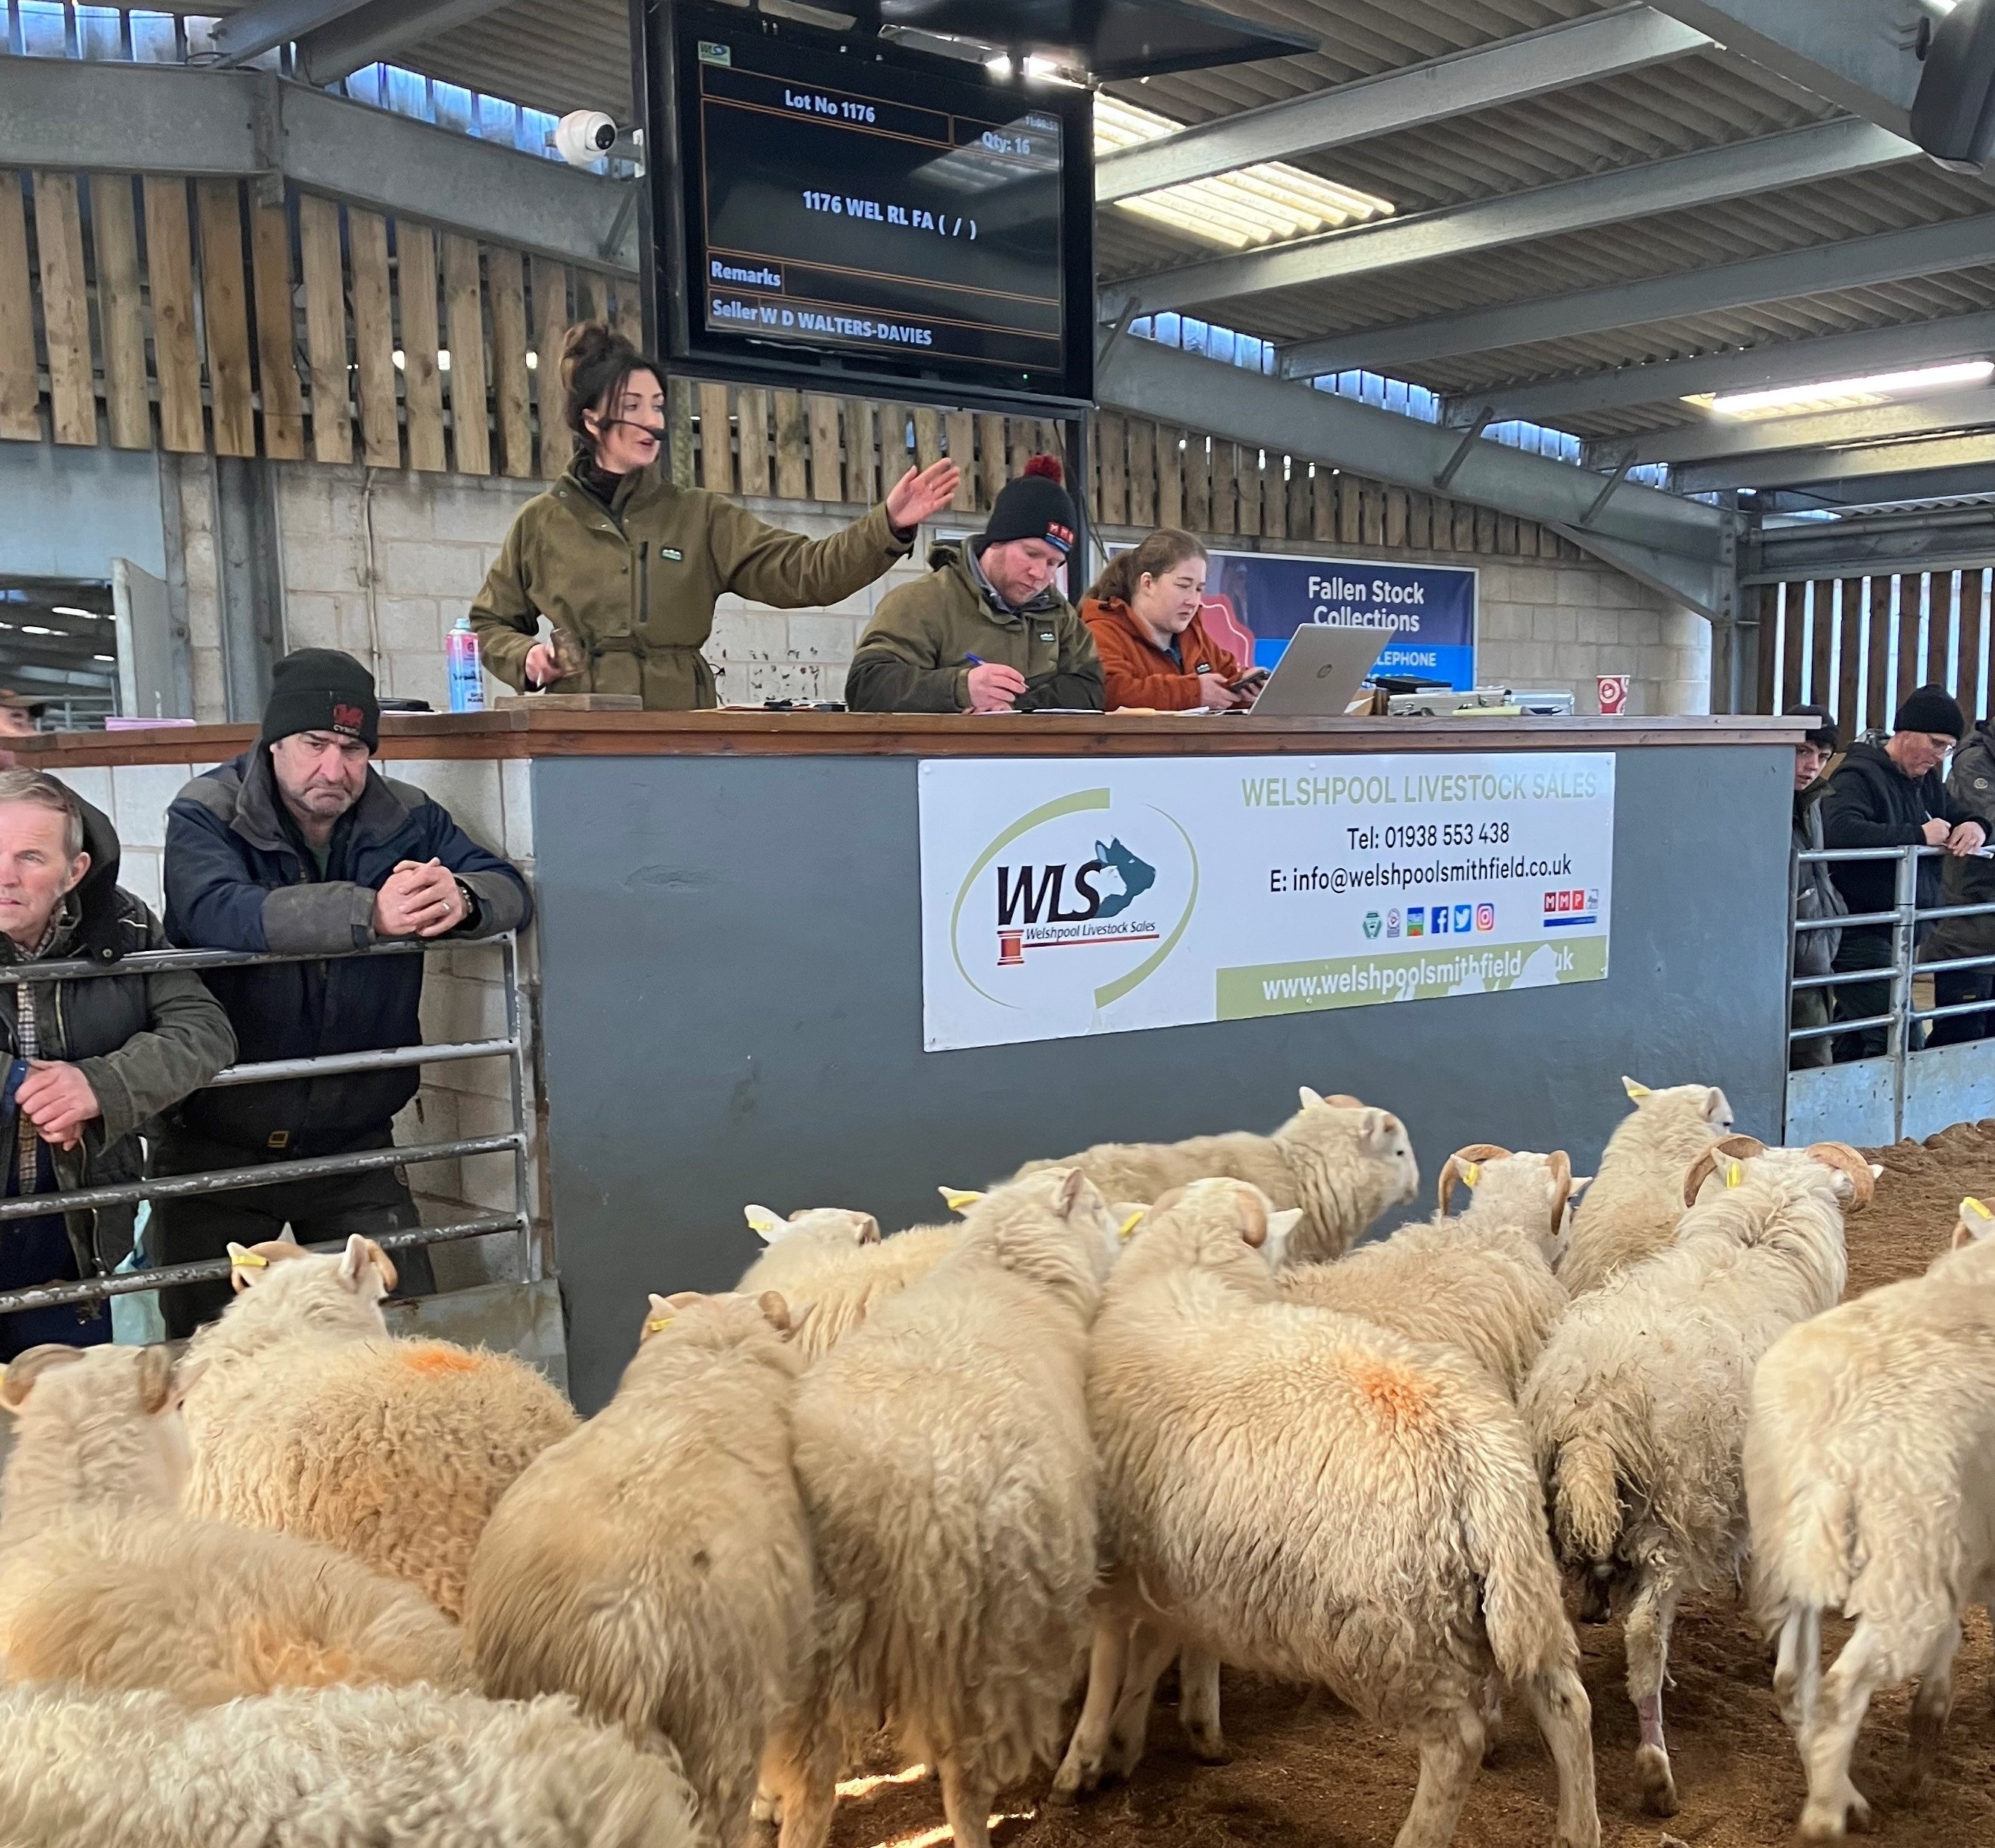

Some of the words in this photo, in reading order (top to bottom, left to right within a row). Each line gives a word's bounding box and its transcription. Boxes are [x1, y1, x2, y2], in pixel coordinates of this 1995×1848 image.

[785, 89, 811, 110] Lot
[814, 95, 837, 115] No
[840, 101, 876, 122] 1176
[982, 130, 1011, 153] Qty:
[1014, 137, 1030, 155] 16
[803, 191, 842, 213] 1176
[846, 198, 883, 221] WEL
[887, 205, 909, 225] RL
[912, 210, 935, 230] FA
[711, 261, 782, 286] Remarks
[712, 299, 757, 320] Seller
[760, 307, 778, 324] W
[782, 310, 794, 326] D
[797, 311, 932, 345] WALTERS-DAVIES
[1308, 577, 1366, 601] Fallen
[1372, 580, 1424, 604] Stock
[1314, 605, 1420, 632] Collections
[1375, 650, 1437, 667] LEPHONE
[1242, 776, 1397, 807] WELSHPOOL
[1404, 773, 1527, 803] LIVESTOCK
[1532, 772, 1598, 800] SALES
[1347, 826, 1379, 850] Tel:
[1385, 825, 1437, 849] 01938
[1443, 823, 1473, 846] 553
[1479, 822, 1510, 844] 438
[1270, 868, 1287, 892] E:
[1293, 853, 1572, 894] info@welshpoolsmithfield.co.uk
[997, 858, 1103, 926] WLS
[1544, 893, 1583, 910] MMP
[1026, 924, 1080, 942] Welshpool
[1082, 921, 1127, 936] Livestock
[1130, 920, 1156, 933] Sales
[1262, 945, 1574, 1000] www.welshpoolsmithfielduk
